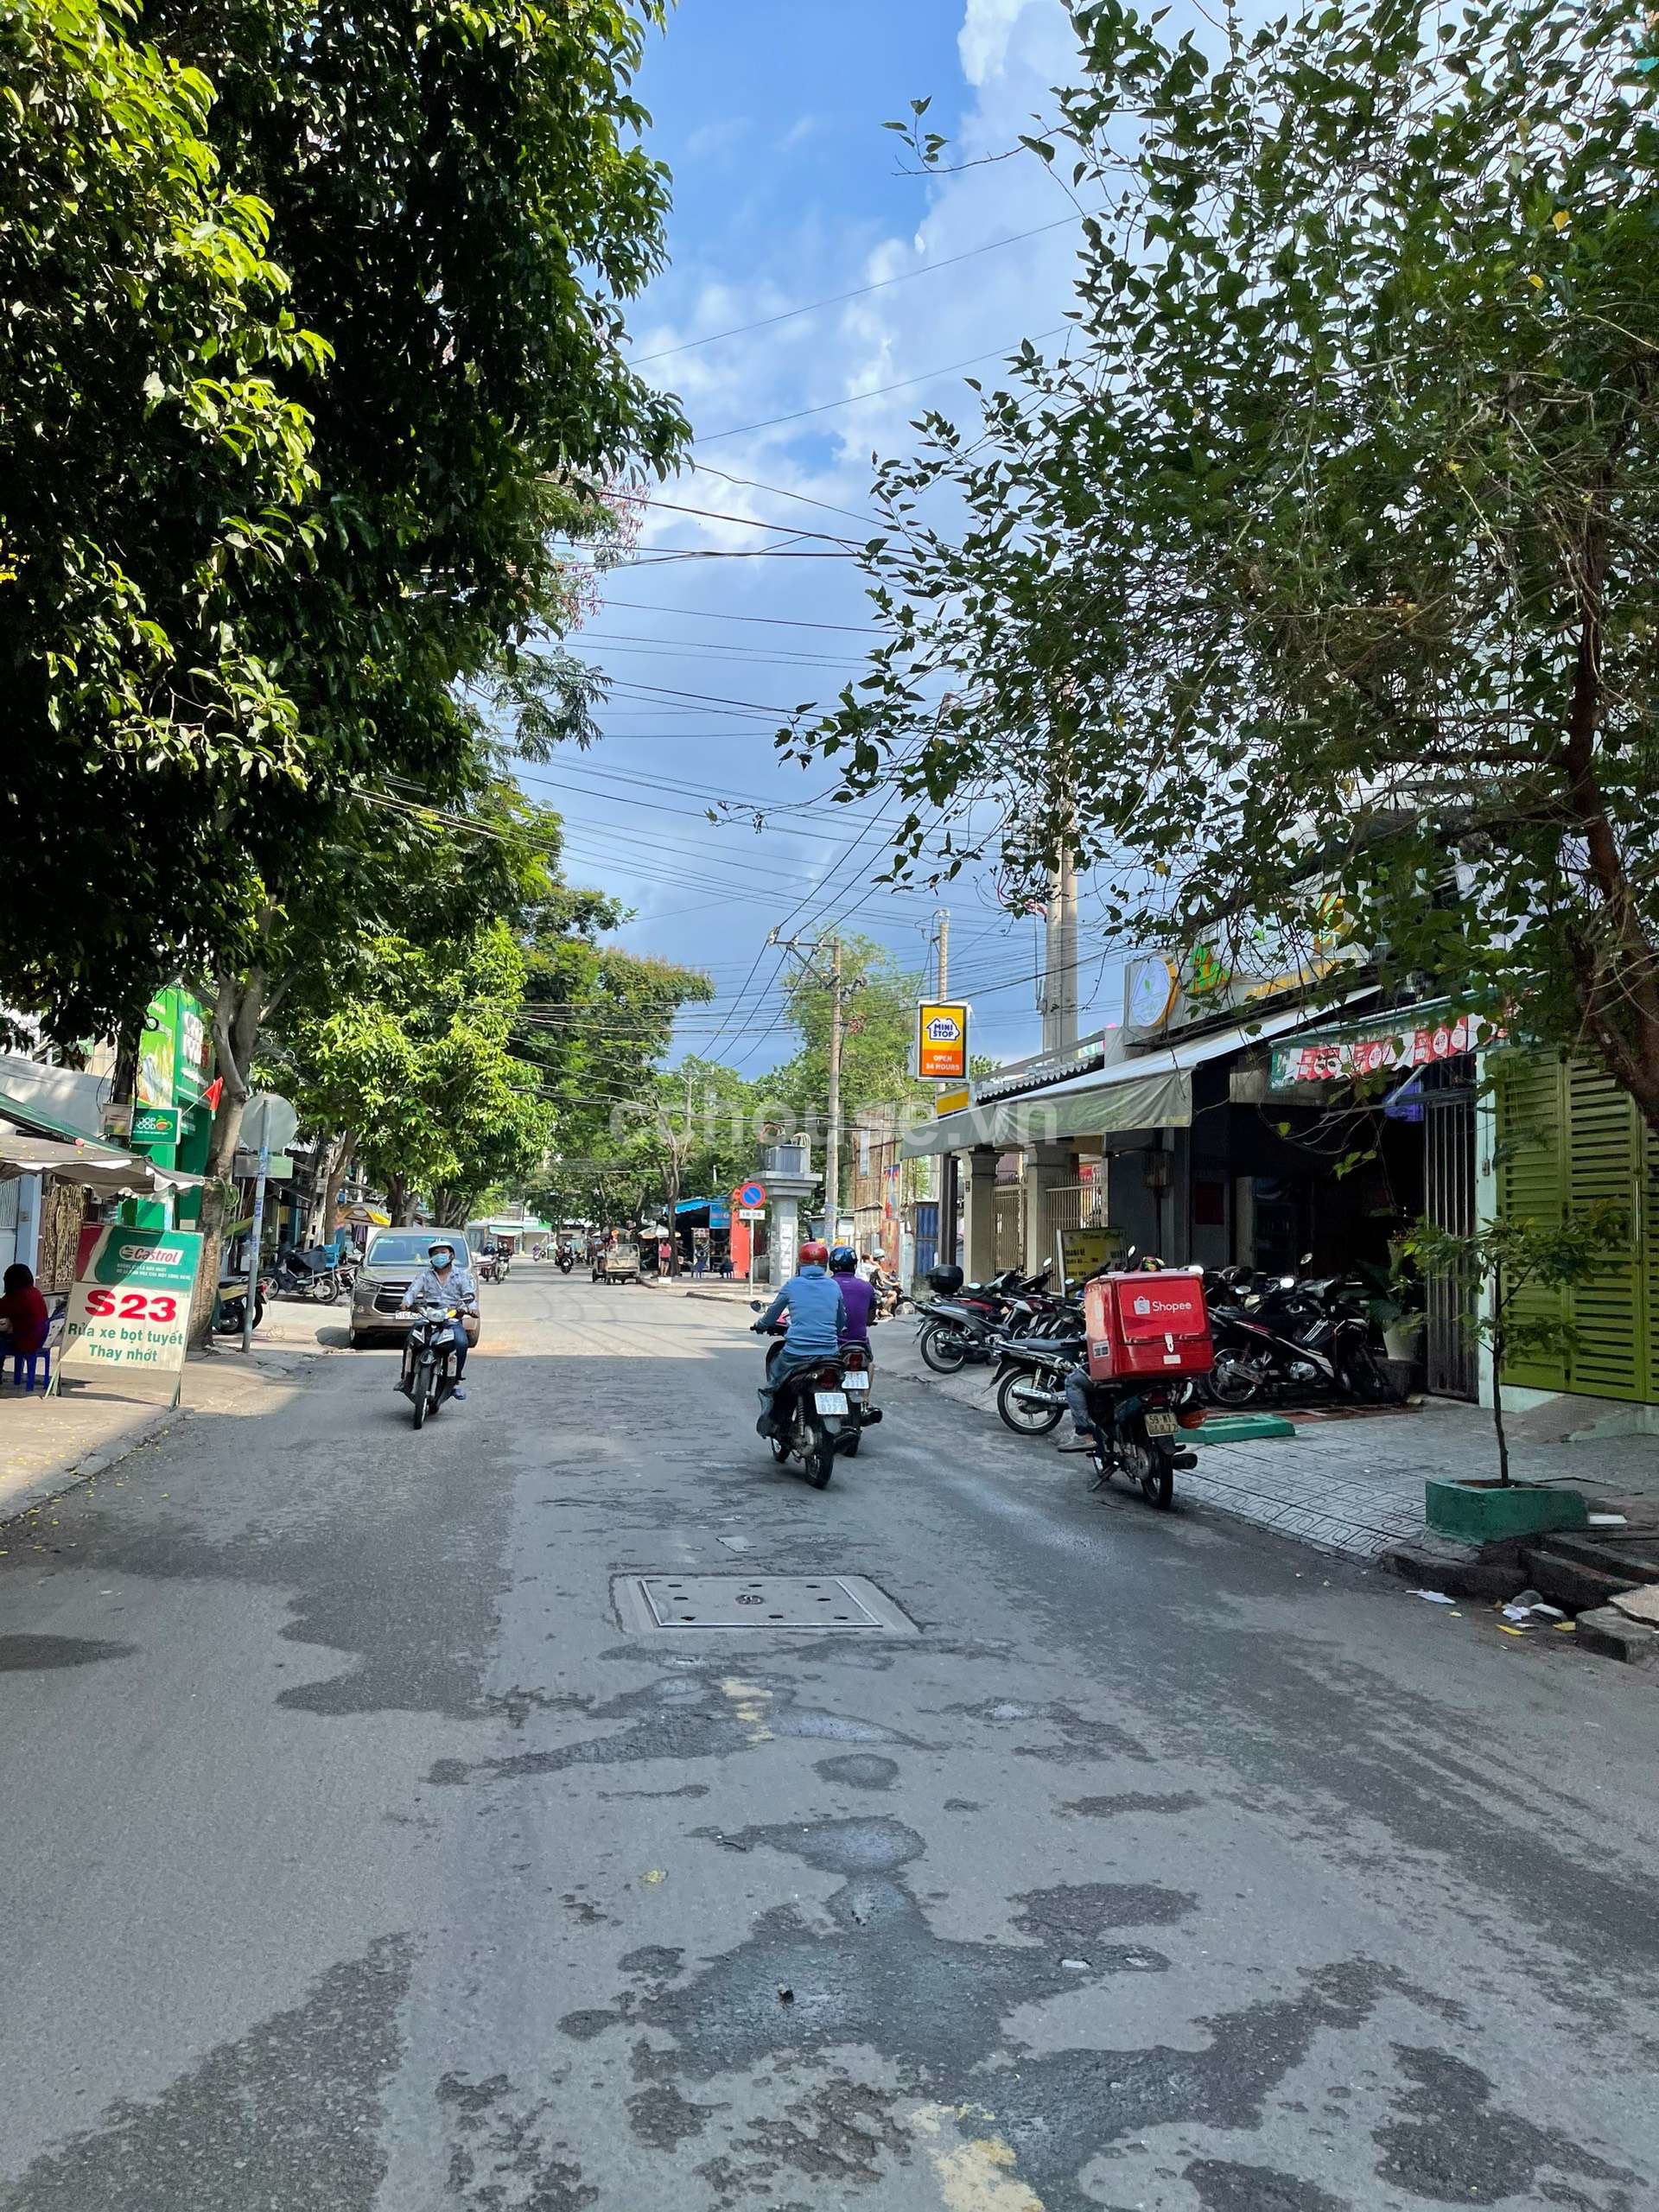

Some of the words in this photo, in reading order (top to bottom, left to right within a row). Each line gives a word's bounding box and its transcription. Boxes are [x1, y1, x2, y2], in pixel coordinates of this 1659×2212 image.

[134, 1248, 179, 1263] Castrol
[85, 1289, 176, 1323] S23
[1152, 1300, 1192, 1313] Shopee
[68, 1322, 94, 1337] Rửa
[99, 1329, 116, 1339] xe
[120, 1328, 143, 1344] bọt
[148, 1331, 183, 1345] tuyết
[90, 1344, 122, 1361] Thay
[127, 1350, 158, 1362] nhớt
